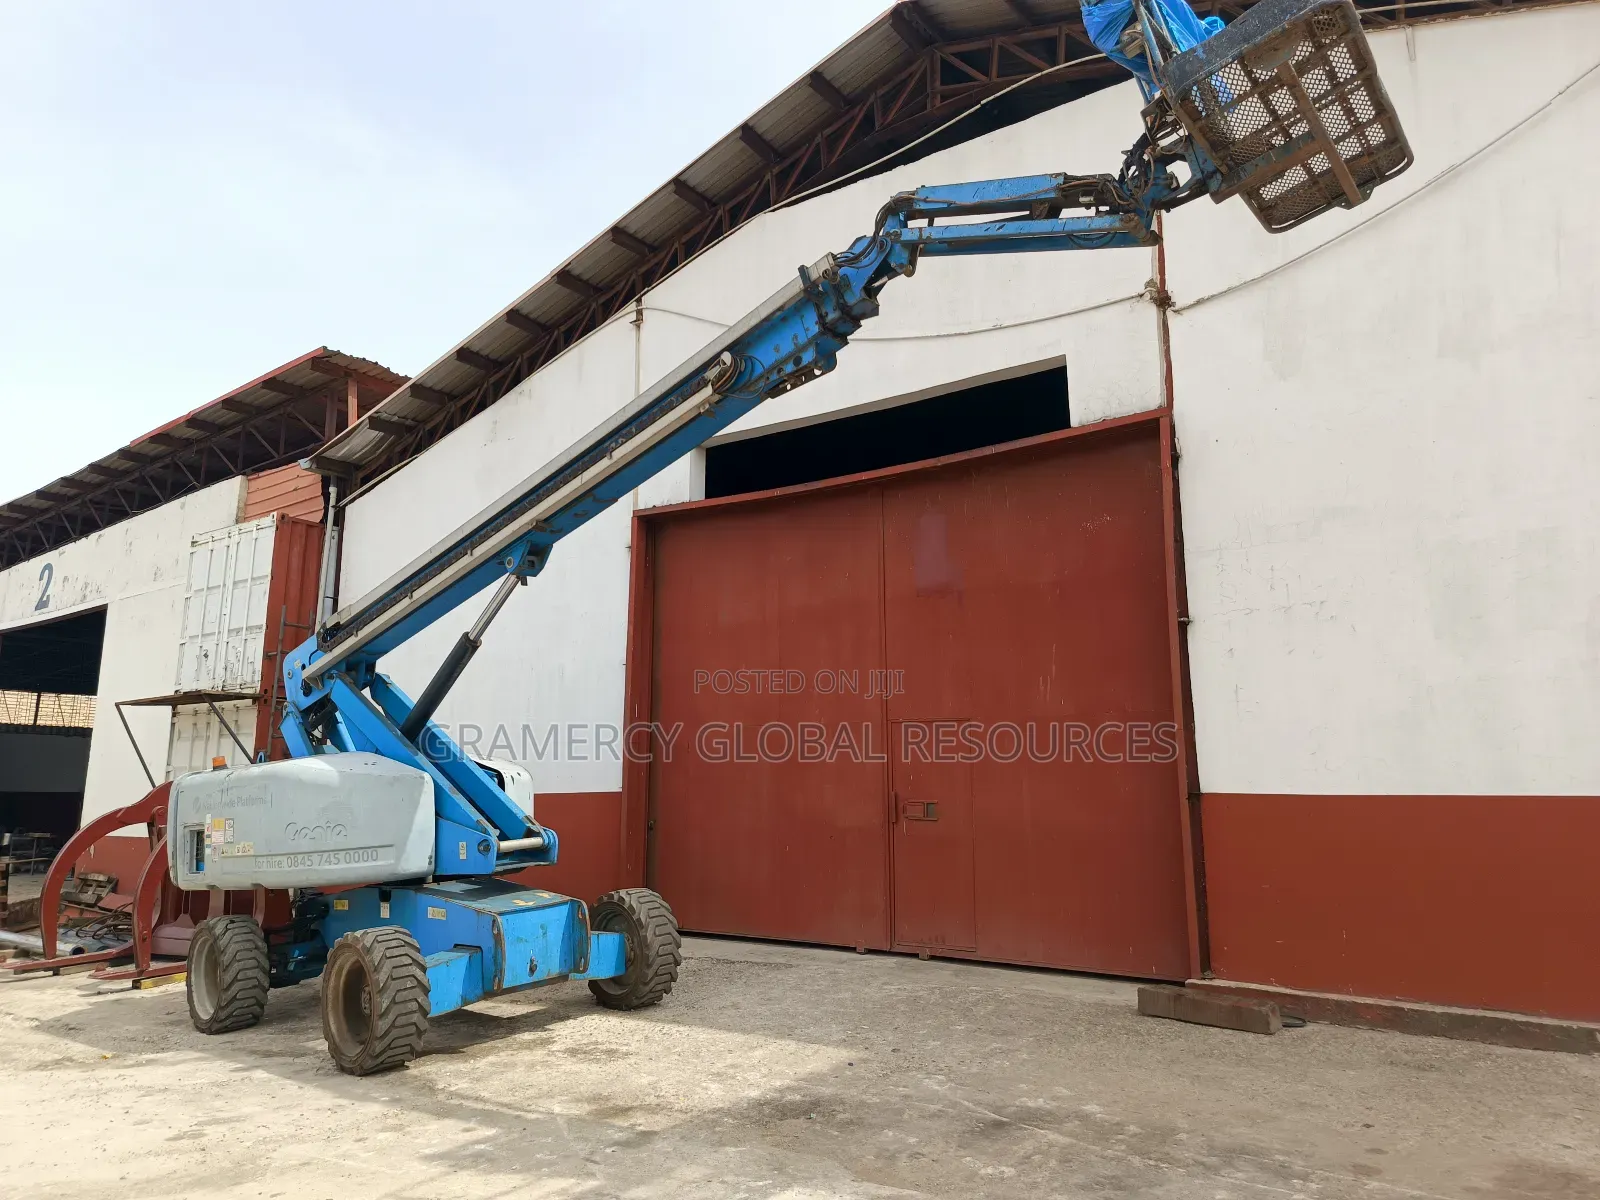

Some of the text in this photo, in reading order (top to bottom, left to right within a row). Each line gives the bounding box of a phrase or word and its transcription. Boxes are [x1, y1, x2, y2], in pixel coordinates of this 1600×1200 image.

[34, 562, 54, 611] 2
[254, 849, 379, 869] for hire: 0845 745 0000
